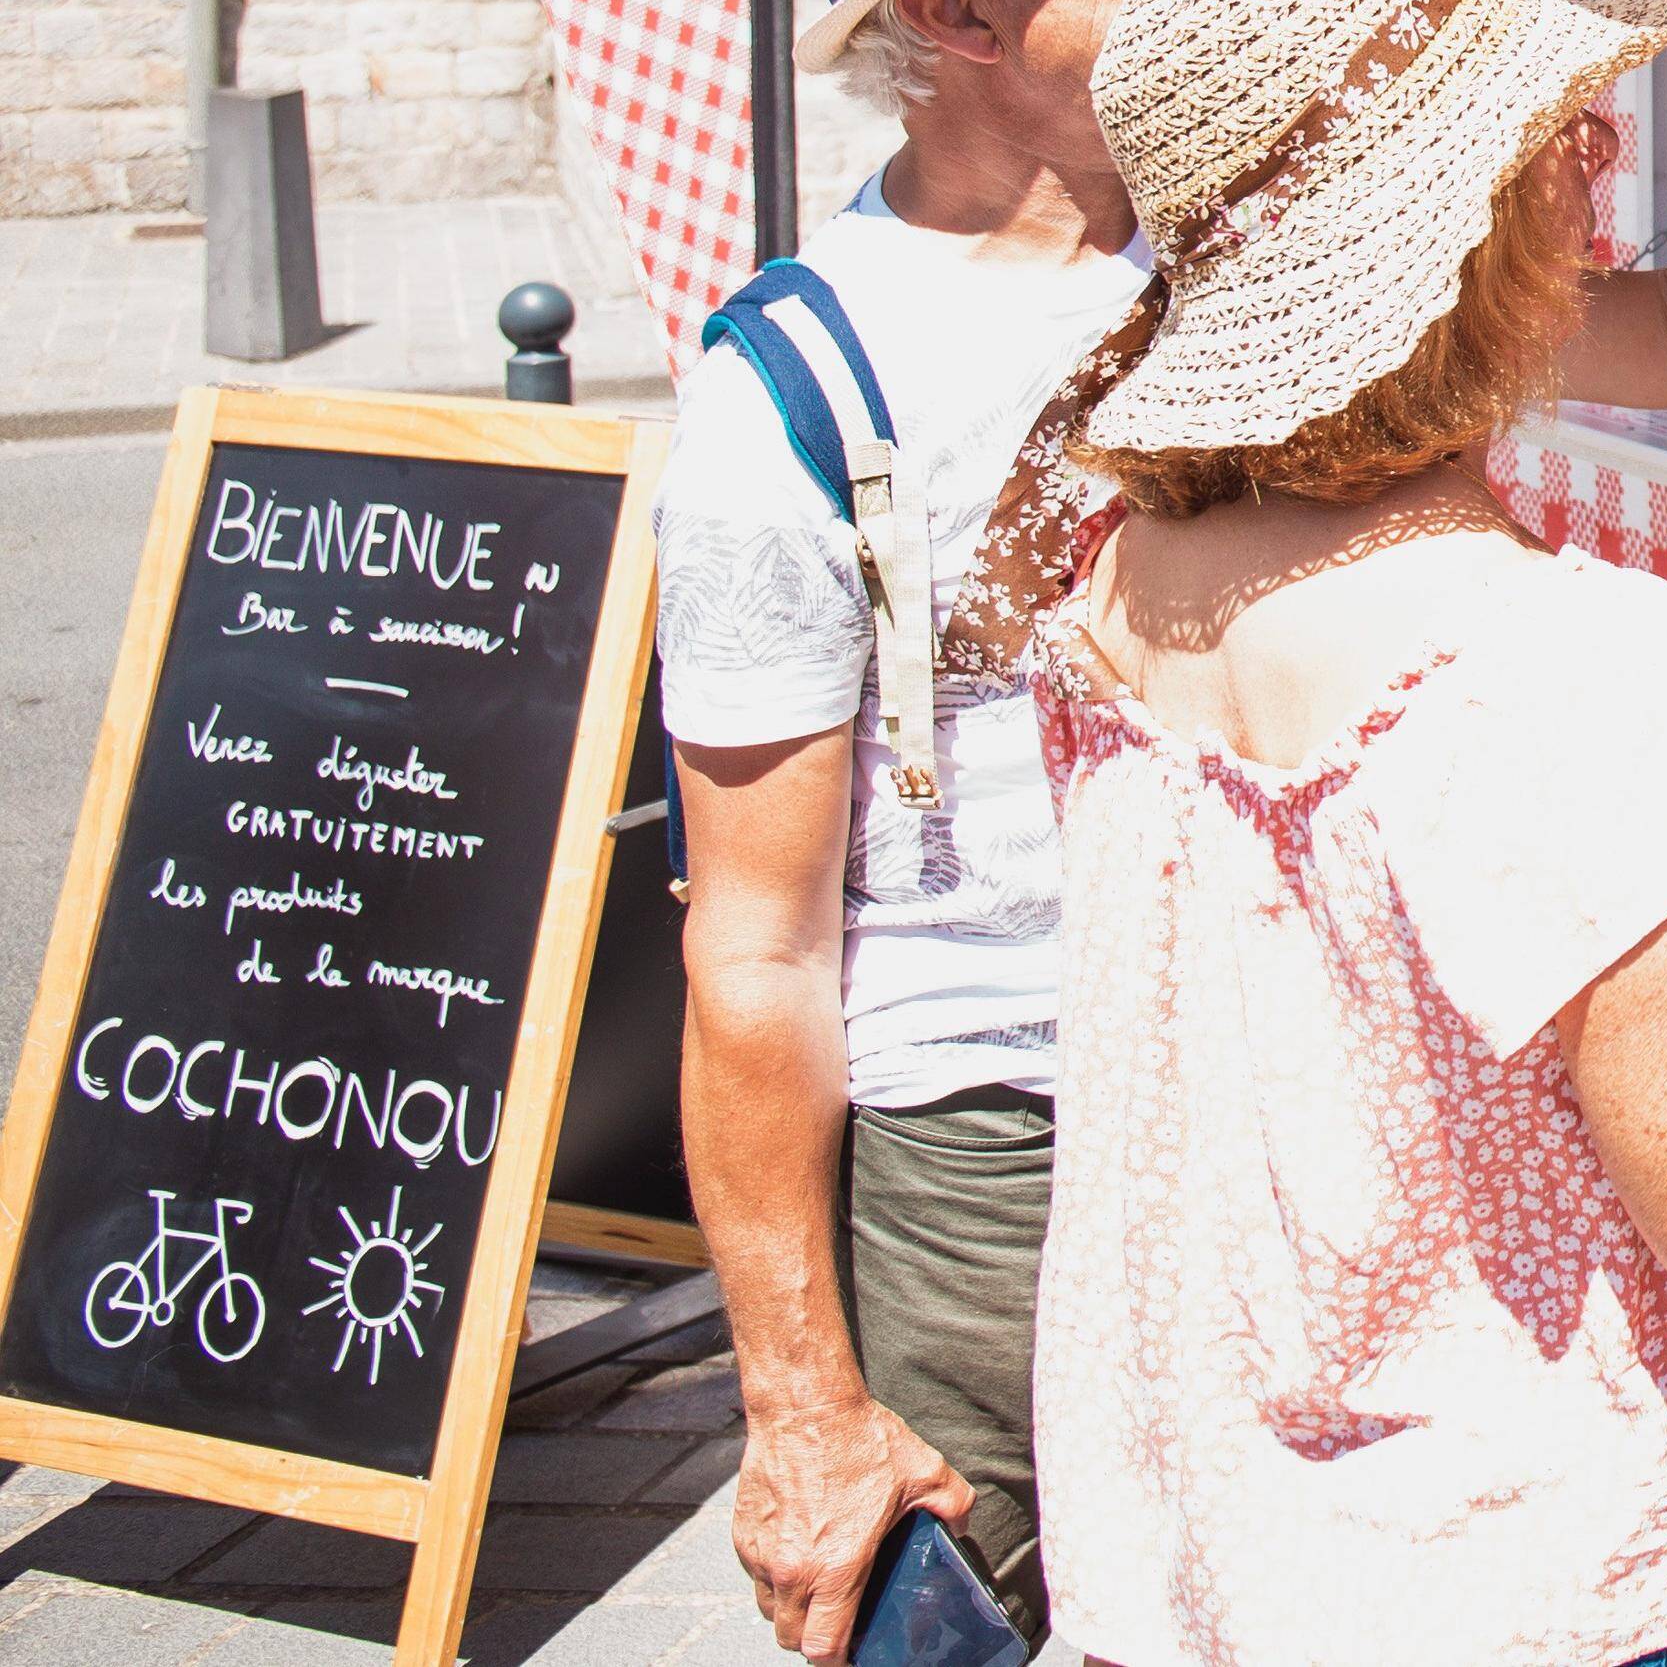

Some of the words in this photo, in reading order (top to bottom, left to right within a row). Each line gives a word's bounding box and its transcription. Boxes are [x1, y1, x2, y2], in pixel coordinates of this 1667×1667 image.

[206, 478, 501, 591] BIENVENUE
[221, 591, 309, 636] Bar
[188, 704, 273, 763] Venez
[317, 736, 458, 812] déguster
[150, 857, 207, 909] les
[228, 872, 364, 934] produits
[237, 939, 281, 985] de
[307, 944, 350, 988] la
[368, 960, 504, 1029] marque
[76, 1016, 502, 1168] COCHONOU
